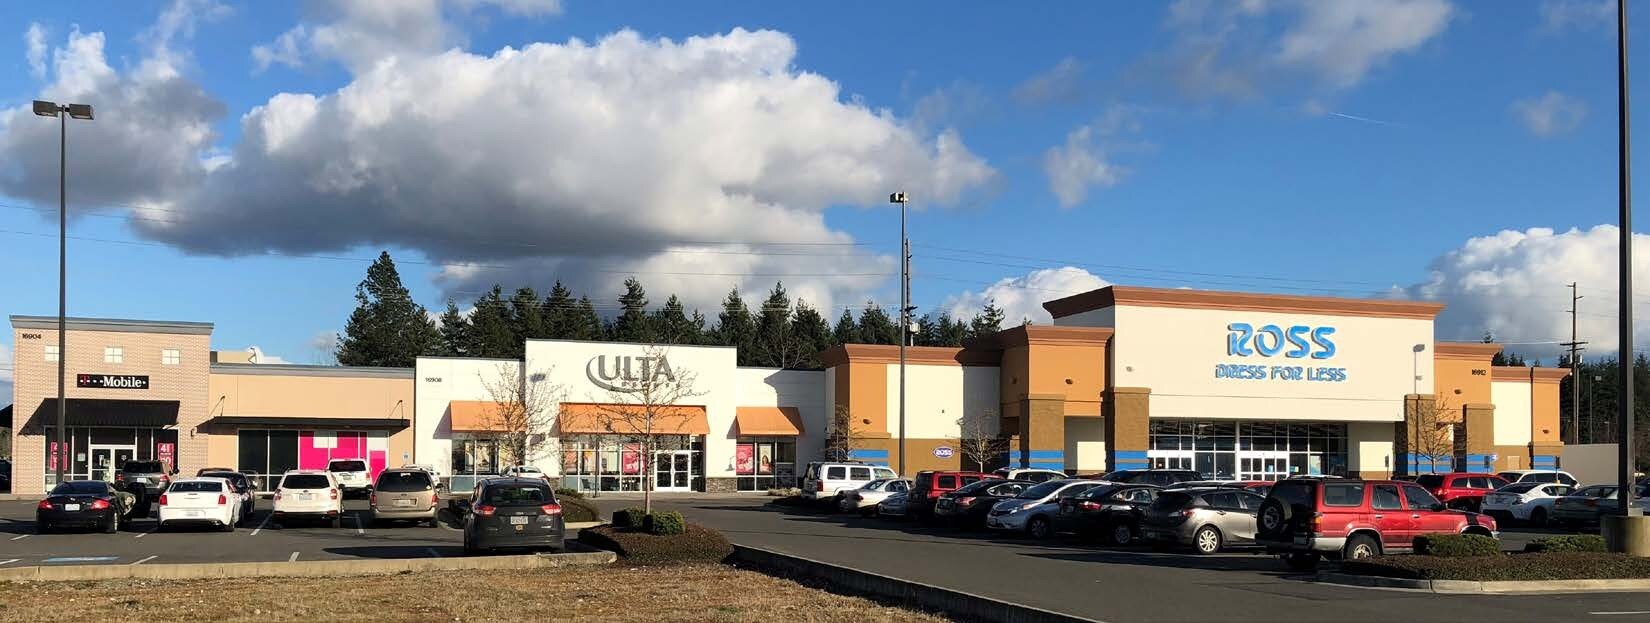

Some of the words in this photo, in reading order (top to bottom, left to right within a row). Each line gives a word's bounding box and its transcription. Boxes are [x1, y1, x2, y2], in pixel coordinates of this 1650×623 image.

[1227, 323, 1336, 359] ROSS
[598, 355, 676, 382] ULTA
[1215, 364, 1267, 380] DRESS
[1271, 366, 1304, 381] FOR
[1307, 367, 1347, 382] LESS
